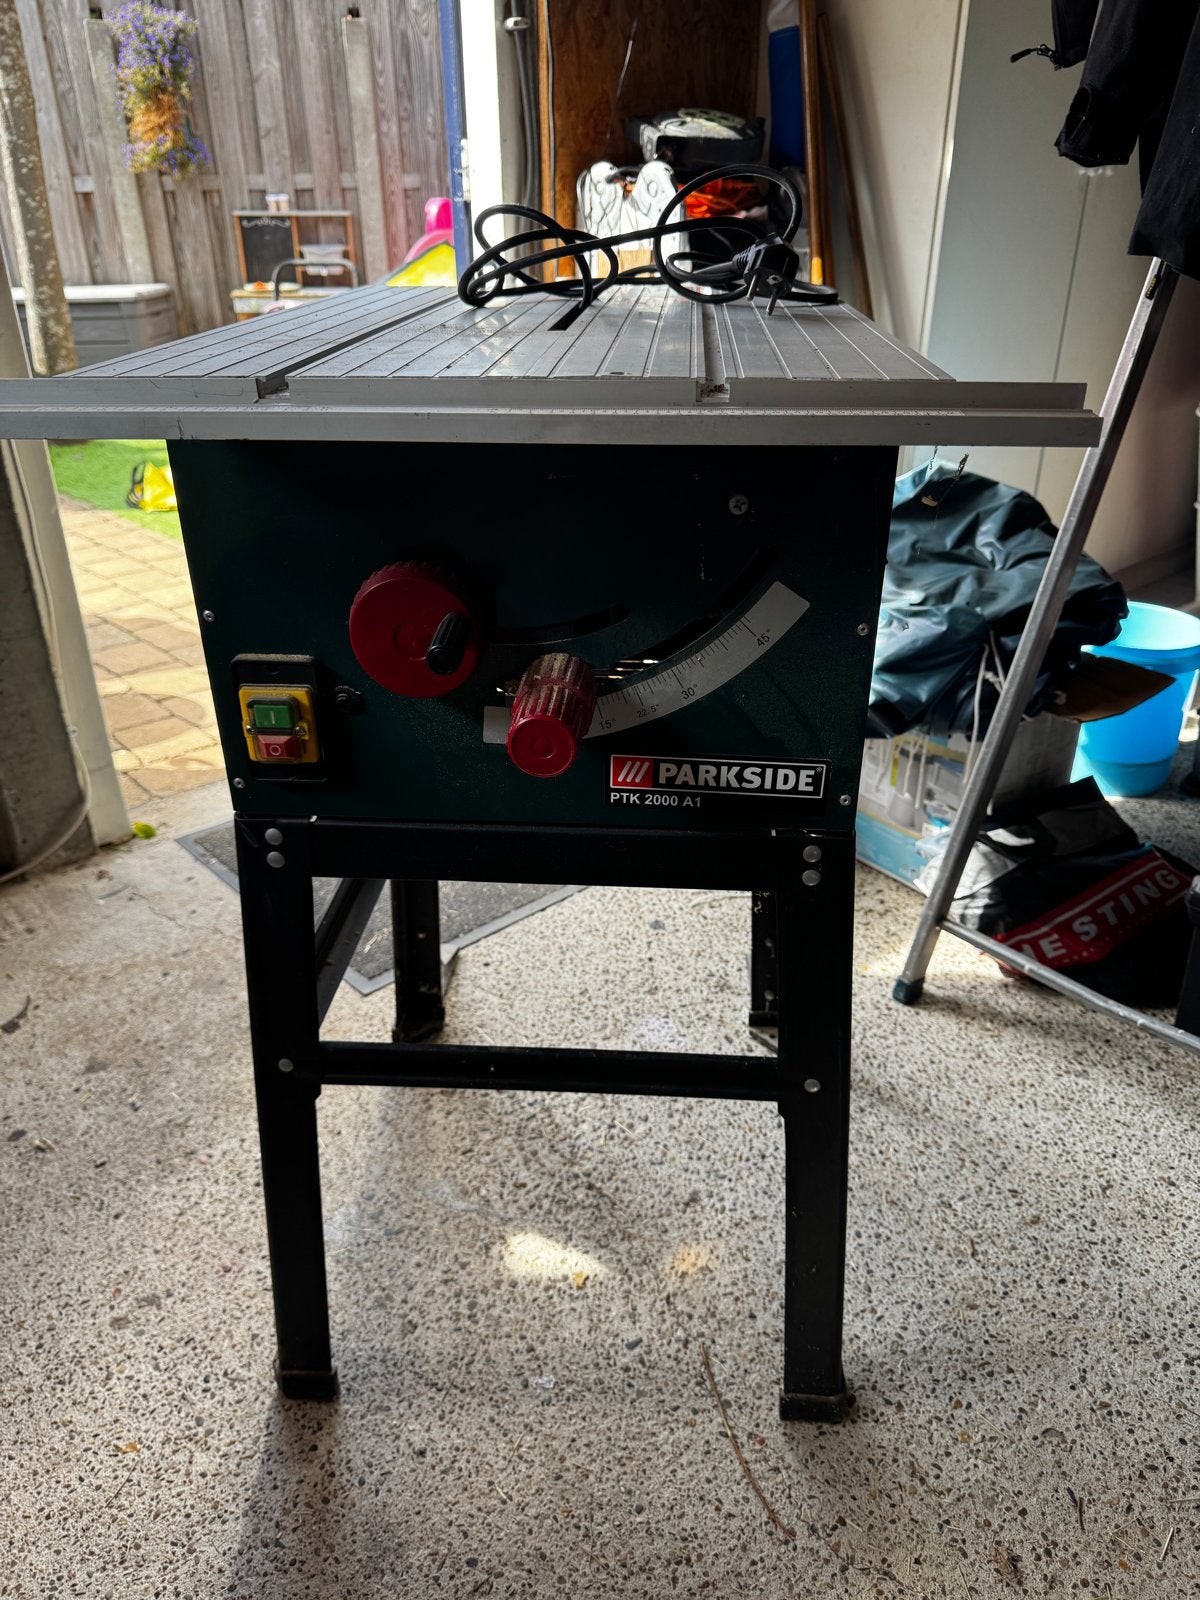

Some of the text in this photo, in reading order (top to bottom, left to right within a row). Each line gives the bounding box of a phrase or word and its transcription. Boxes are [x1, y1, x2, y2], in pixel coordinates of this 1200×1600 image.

[609, 792, 702, 808] PTK 2000 A1
[1071, 869, 1181, 942] STING
